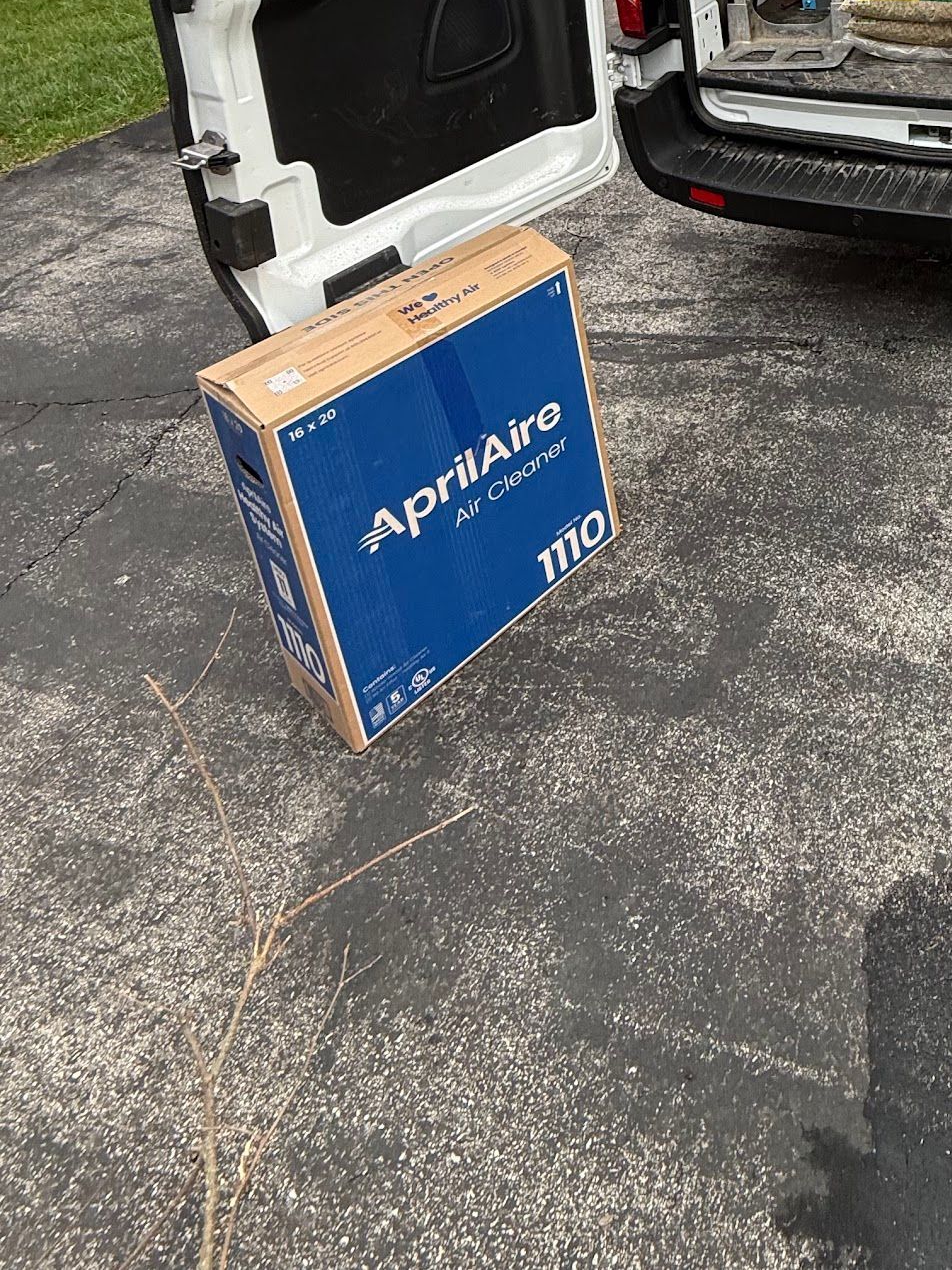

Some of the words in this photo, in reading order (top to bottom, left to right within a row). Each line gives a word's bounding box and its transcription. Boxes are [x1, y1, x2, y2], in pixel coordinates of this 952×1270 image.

[404, 256, 455, 289] OPEN
[301, 307, 352, 332] SIDE
[397, 300, 424, 315] We
[407, 290, 461, 325] Healthy
[462, 281, 481, 297] Air
[288, 426, 305, 442] 16
[308, 420, 317, 432] x
[318, 408, 337, 427] 20
[357, 401, 562, 555] AprilAire
[455, 496, 482, 528] Air
[487, 436, 568, 501] Cleaner
[537, 509, 605, 584] 1110
[277, 613, 326, 684] 1110
[362, 663, 397, 693] Contains:
[390, 690, 401, 704] 5
